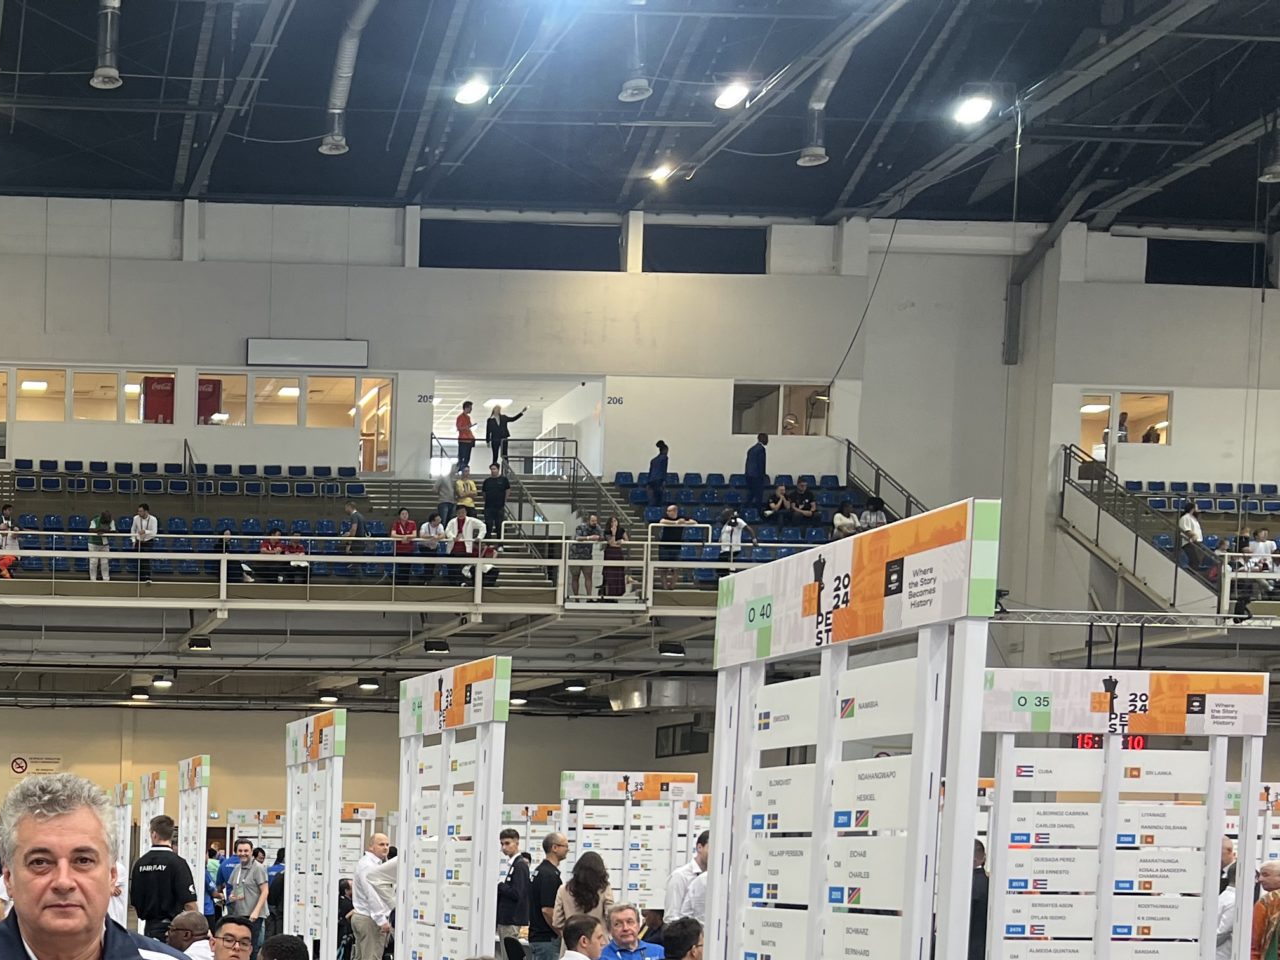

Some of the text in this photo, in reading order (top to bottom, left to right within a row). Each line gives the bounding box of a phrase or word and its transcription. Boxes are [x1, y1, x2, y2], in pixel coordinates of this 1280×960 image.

[607, 396, 623, 405] 206
[912, 566, 934, 578] Where
[833, 573, 851, 592] 20
[908, 575, 937, 589] the Story
[908, 586, 936, 600] Becomes
[832, 591, 850, 610] 24
[909, 597, 934, 610] History
[759, 602, 772, 619] 40
[816, 610, 833, 630] PE
[815, 629, 833, 646] ST
[1034, 696, 1050, 707] 35
[1128, 693, 1149, 703] 20
[1127, 703, 1149, 713] 24
[1108, 713, 1128, 722] PE
[1108, 723, 1128, 733] ST
